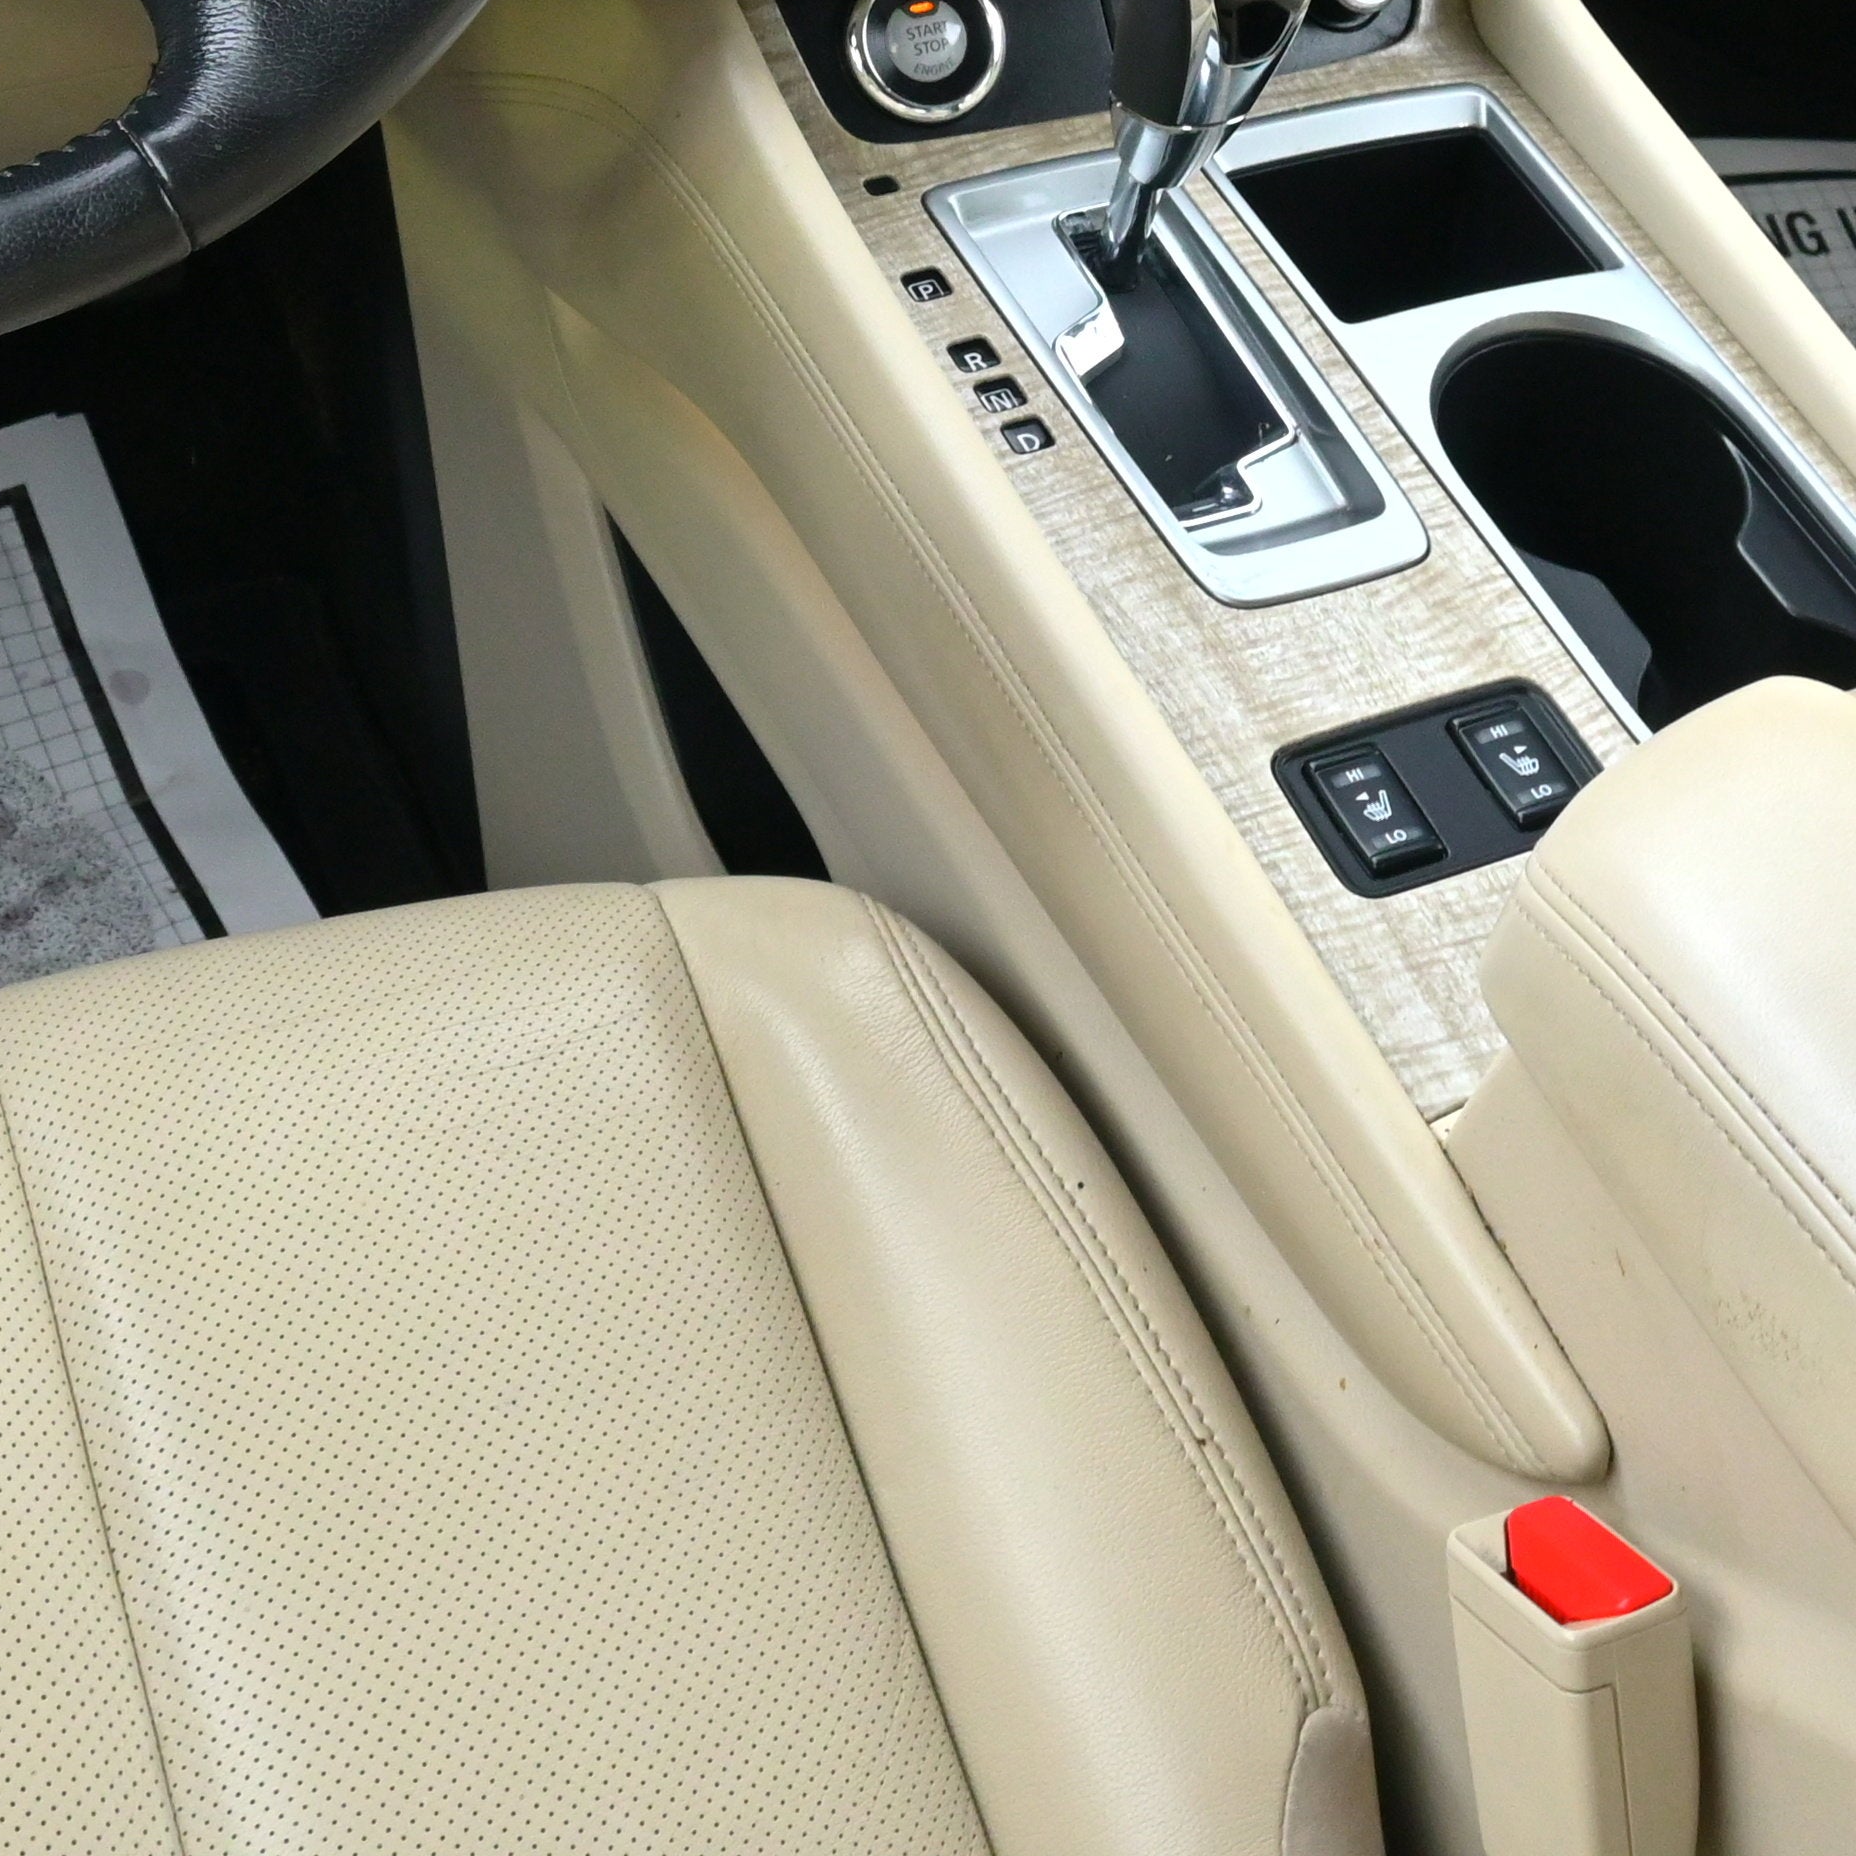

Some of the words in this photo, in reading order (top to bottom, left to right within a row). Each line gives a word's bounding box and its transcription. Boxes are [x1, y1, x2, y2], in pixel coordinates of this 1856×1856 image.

[906, 20, 947, 41] START
[914, 38, 949, 56] STOP
[918, 284, 933, 300] P
[963, 352, 988, 371] R
[990, 393, 1011, 411] N
[1017, 433, 1040, 452] D
[1490, 724, 1509, 740] HI
[1345, 767, 1364, 783] HI
[1531, 783, 1552, 800] LO
[1385, 828, 1408, 844] LO
